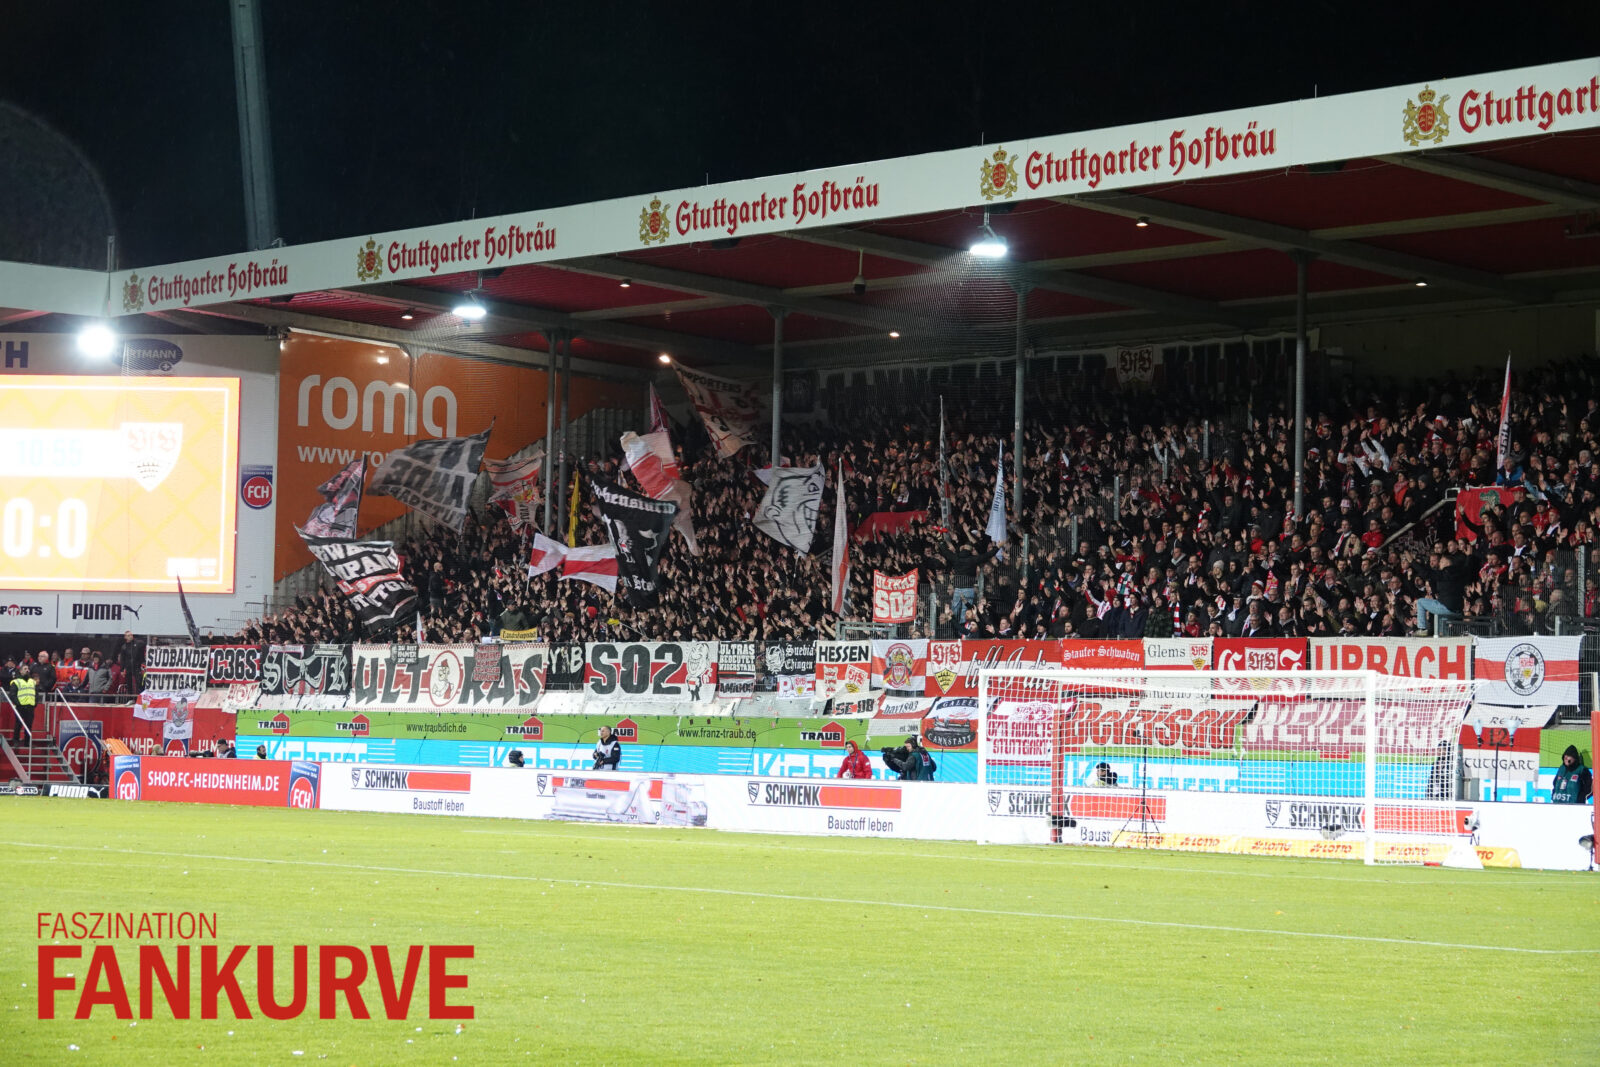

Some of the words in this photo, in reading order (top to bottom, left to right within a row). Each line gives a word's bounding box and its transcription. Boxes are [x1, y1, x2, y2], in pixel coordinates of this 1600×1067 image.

[1025, 141, 1163, 190] Stuttgarter
[1168, 121, 1276, 177] Hofbräu
[676, 196, 788, 238] Stuttgarter
[793, 177, 880, 225] Hofbräu
[387, 237, 481, 274] Stuttgarter
[484, 221, 557, 264] Hofbräu
[147, 271, 225, 306] Stuttgarter
[227, 258, 289, 297] Hofbräu
[297, 374, 458, 438] roma
[247, 485, 270, 499] FCH
[3, 498, 87, 558] 0:0
[875, 574, 915, 590] ULTRAS
[72, 603, 123, 621] PUMA
[146, 646, 208, 668] SÜDBANDE
[720, 643, 755, 655] ULTRAS
[819, 646, 869, 662] HESSEN
[1064, 647, 1096, 661] Staufer
[1097, 645, 1140, 662] Schwaben
[1147, 644, 1186, 658] Glems
[1315, 644, 1466, 691] URBACH
[145, 672, 206, 691] STUTTGART
[258, 721, 287, 729] TRAUB
[336, 722, 366, 731] TRAUB
[406, 722, 467, 733] www.traubdich.de
[506, 726, 540, 735] TRAUB
[678, 728, 757, 740] www.franz-traub.de
[801, 731, 841, 741] TRAUB
[1490, 728, 1509, 747] 12
[68, 748, 94, 765] FCH
[148, 770, 280, 792] SHOP.FC-HEIDENHEIM.DE
[365, 769, 408, 790] SCHWENK
[48, 785, 90, 798] PUMA
[120, 783, 137, 800] FCH
[293, 788, 312, 808] FCH
[765, 783, 820, 806] SCHWENK
[413, 797, 443, 811] Baustoff
[444, 799, 465, 812] leben
[1008, 792, 1071, 816] SCHWEK
[828, 814, 866, 830] Baustoff
[867, 817, 893, 832] leben
[1289, 803, 1363, 829] SCHWENK
[1190, 837, 1220, 847] LOTTO
